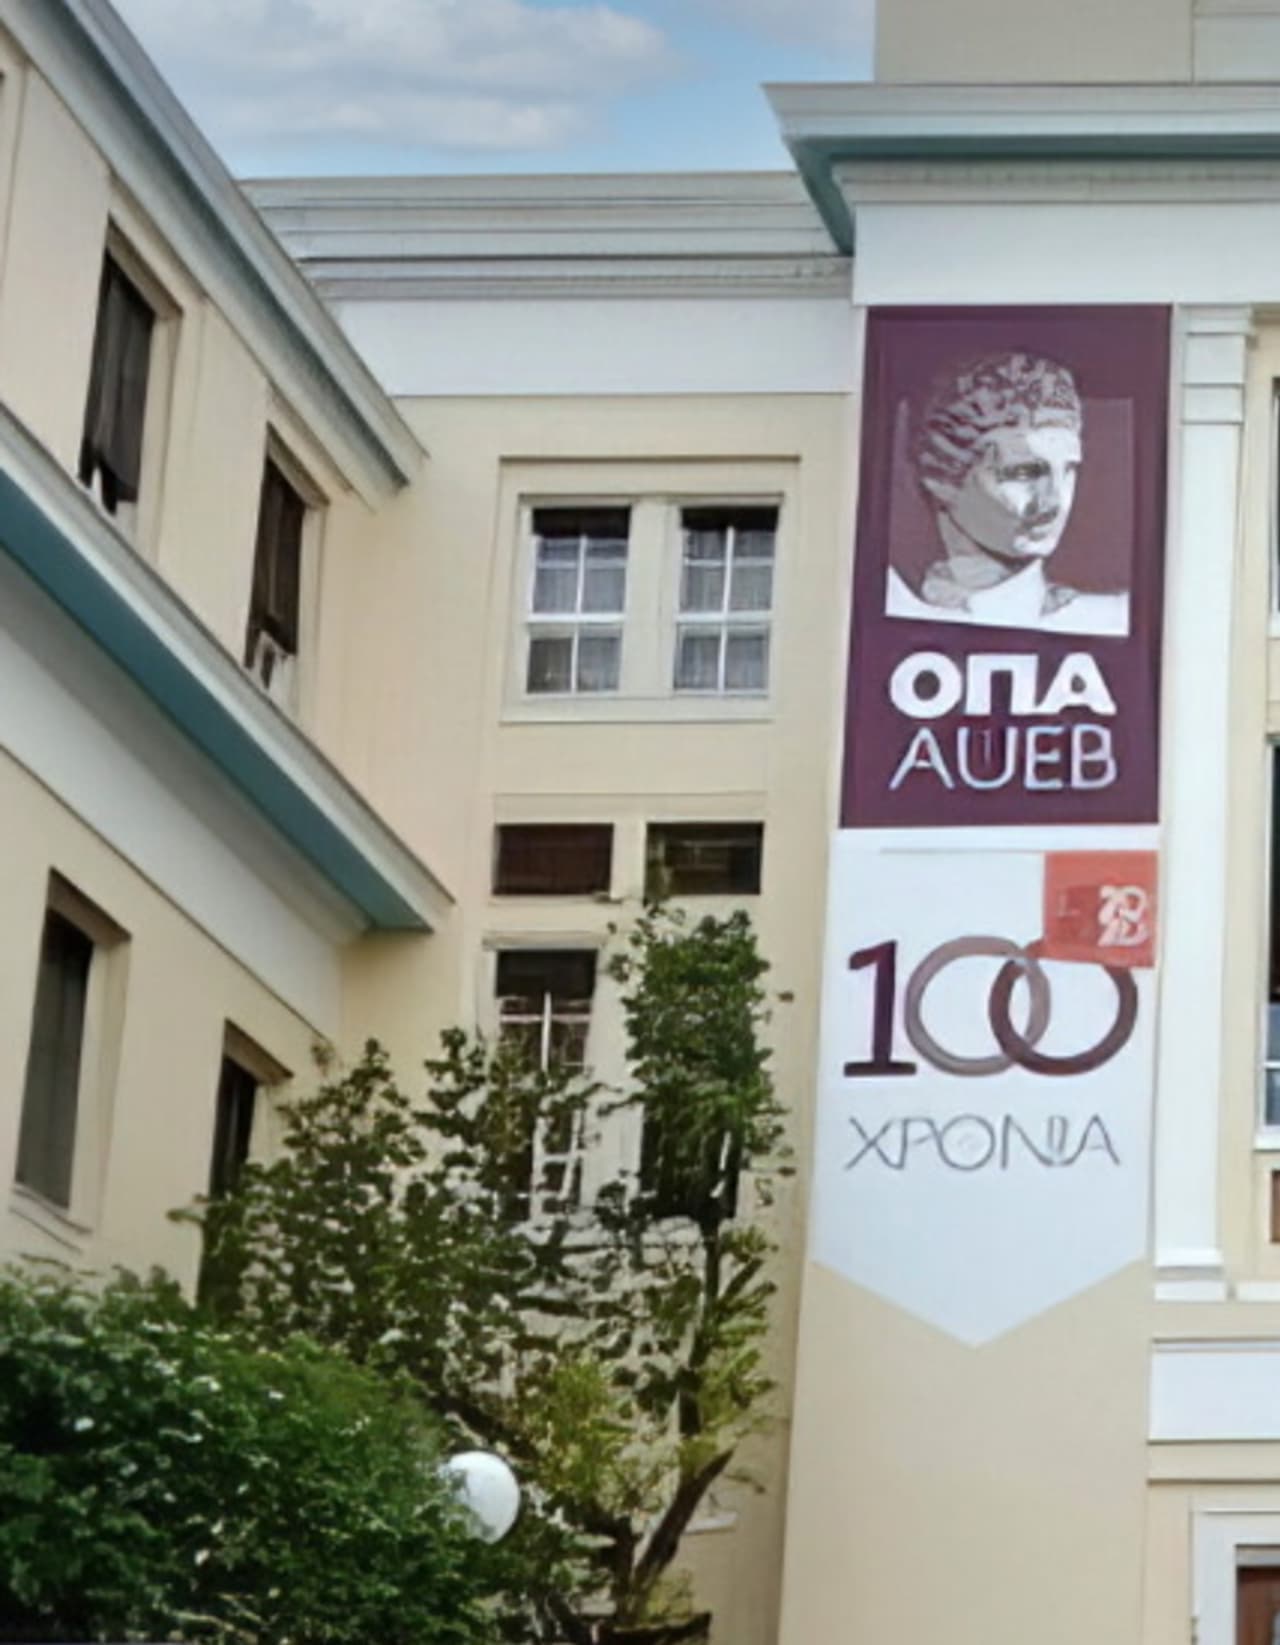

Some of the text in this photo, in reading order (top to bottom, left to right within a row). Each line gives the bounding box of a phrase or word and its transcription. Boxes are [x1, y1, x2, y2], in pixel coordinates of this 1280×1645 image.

[889, 651, 1117, 718] ΟΠΑ
[889, 723, 1118, 790] AUEB
[843, 935, 1139, 1077] 100
[844, 1114, 1121, 1171] ΧΡΟΝΙΑ
